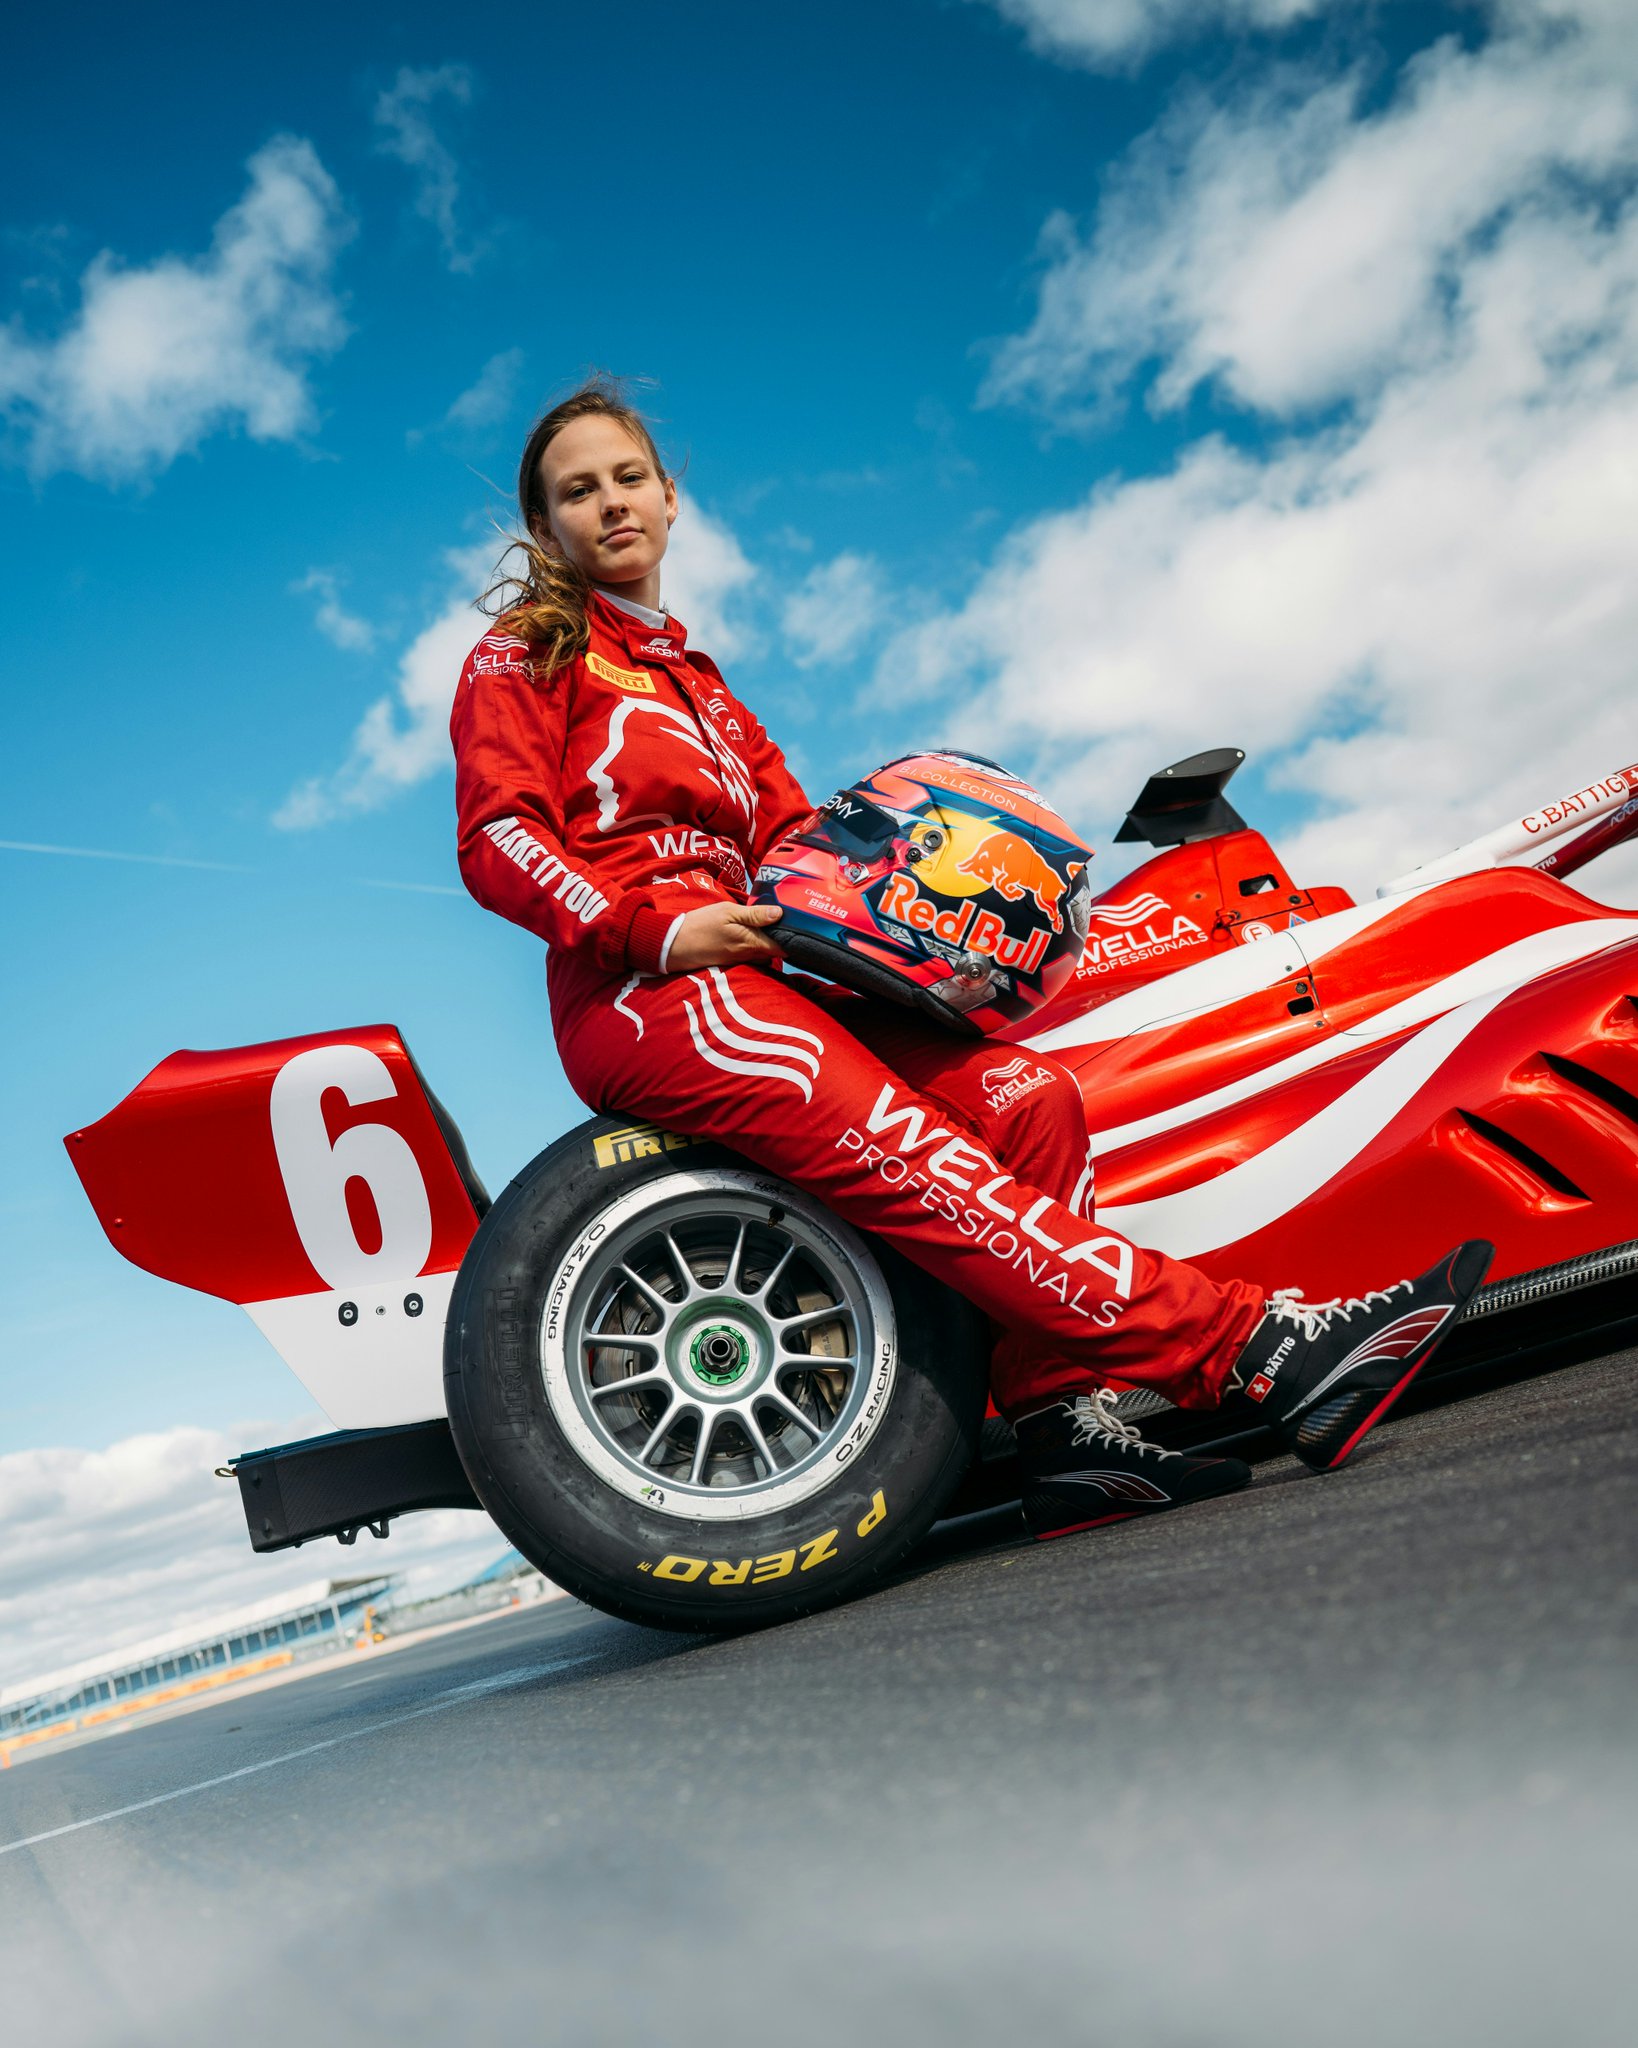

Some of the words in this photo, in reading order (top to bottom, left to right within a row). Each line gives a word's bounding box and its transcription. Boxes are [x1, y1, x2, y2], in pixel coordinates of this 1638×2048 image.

[467, 652, 536, 684] ELLA
[591, 656, 648, 690] PIRELLI
[920, 770, 1018, 811] COLLECTION
[481, 816, 550, 873] MAKE
[530, 854, 571, 888] IT
[552, 872, 610, 924] YOU
[876, 870, 978, 948] Red
[963, 907, 1053, 976] Bull
[1075, 931, 1209, 981] PROFESSIONALS
[985, 1066, 1052, 1109] WELLA
[994, 1074, 1058, 1116] PROFESSIONALS
[269, 1044, 433, 1290] 6
[865, 1082, 1134, 1300] WELLA
[834, 1127, 1124, 1328] PROFESSIONALS
[547, 1264, 576, 1340] RACING
[865, 1342, 892, 1420] RACING
[1262, 1336, 1296, 1378] BÄTTIG
[856, 1489, 888, 1538] P
[651, 1528, 839, 1586] ZERO
